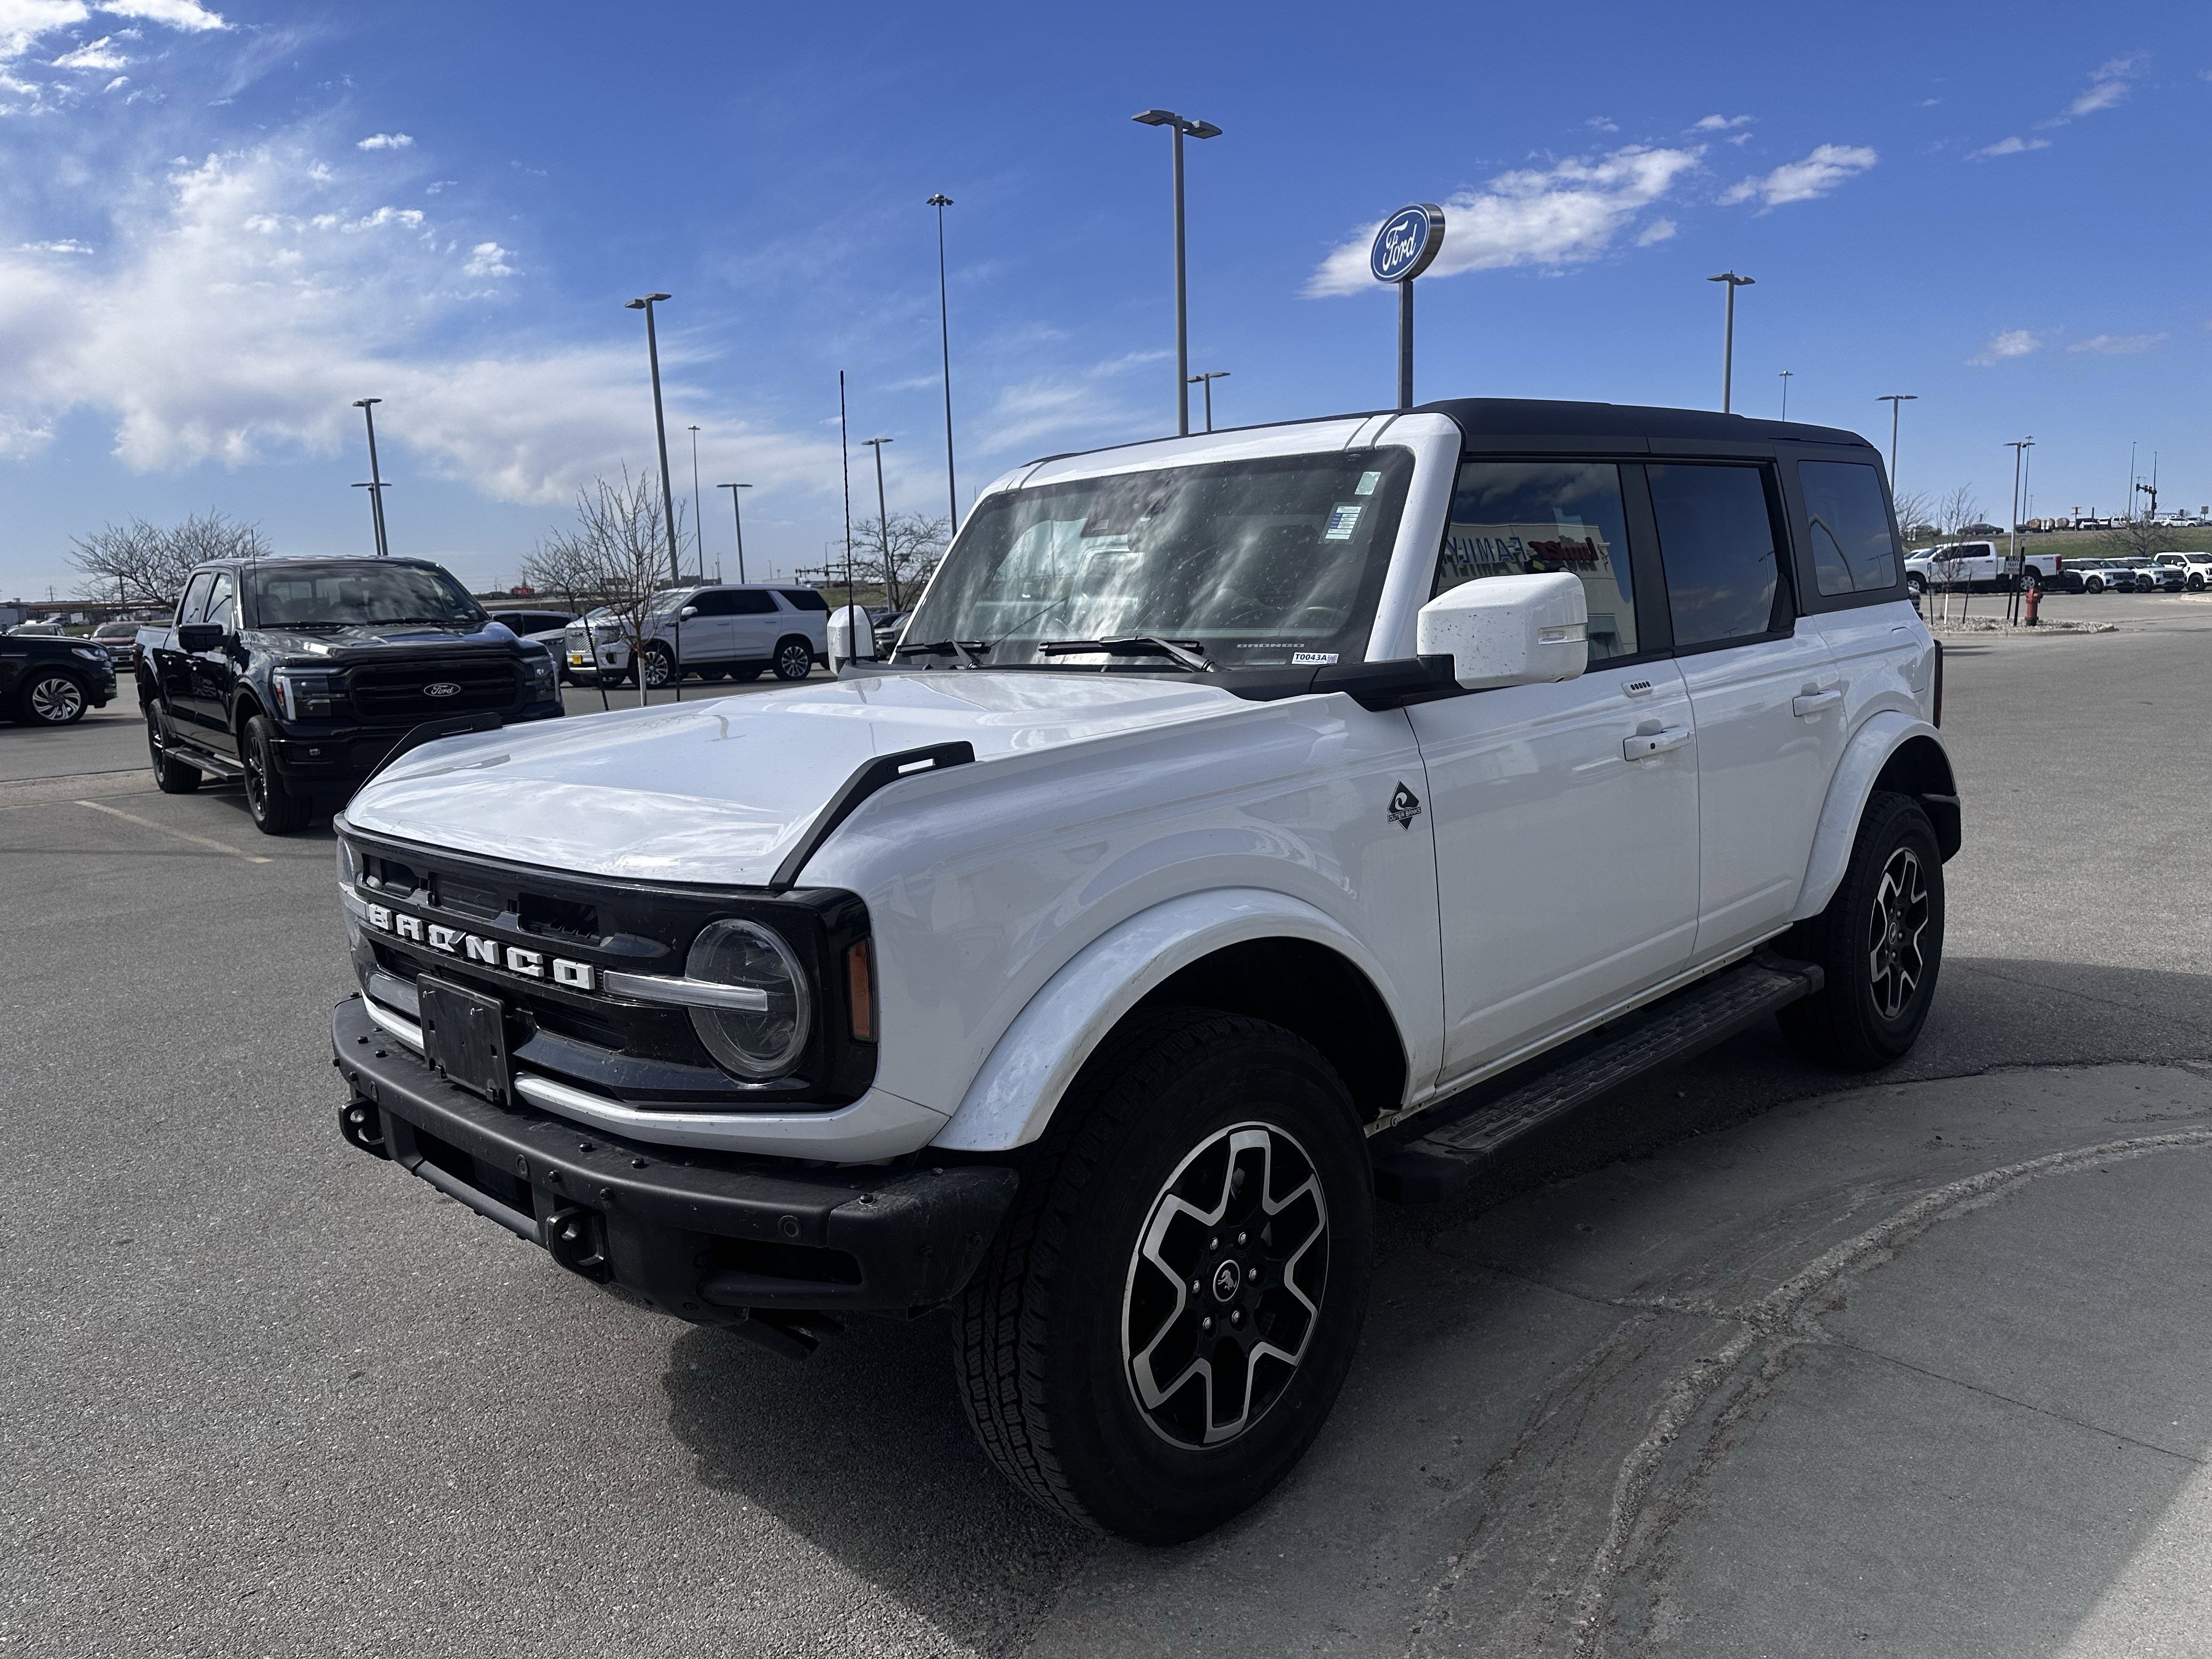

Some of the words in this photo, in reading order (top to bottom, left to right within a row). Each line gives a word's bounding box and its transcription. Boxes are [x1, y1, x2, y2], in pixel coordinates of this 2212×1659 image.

[1382, 220, 1417, 271] Ford
[431, 685, 454, 695] Ford
[1389, 812, 1404, 821] OUTER
[1406, 808, 1421, 816] BANKS
[368, 903, 595, 990] BRONCO
